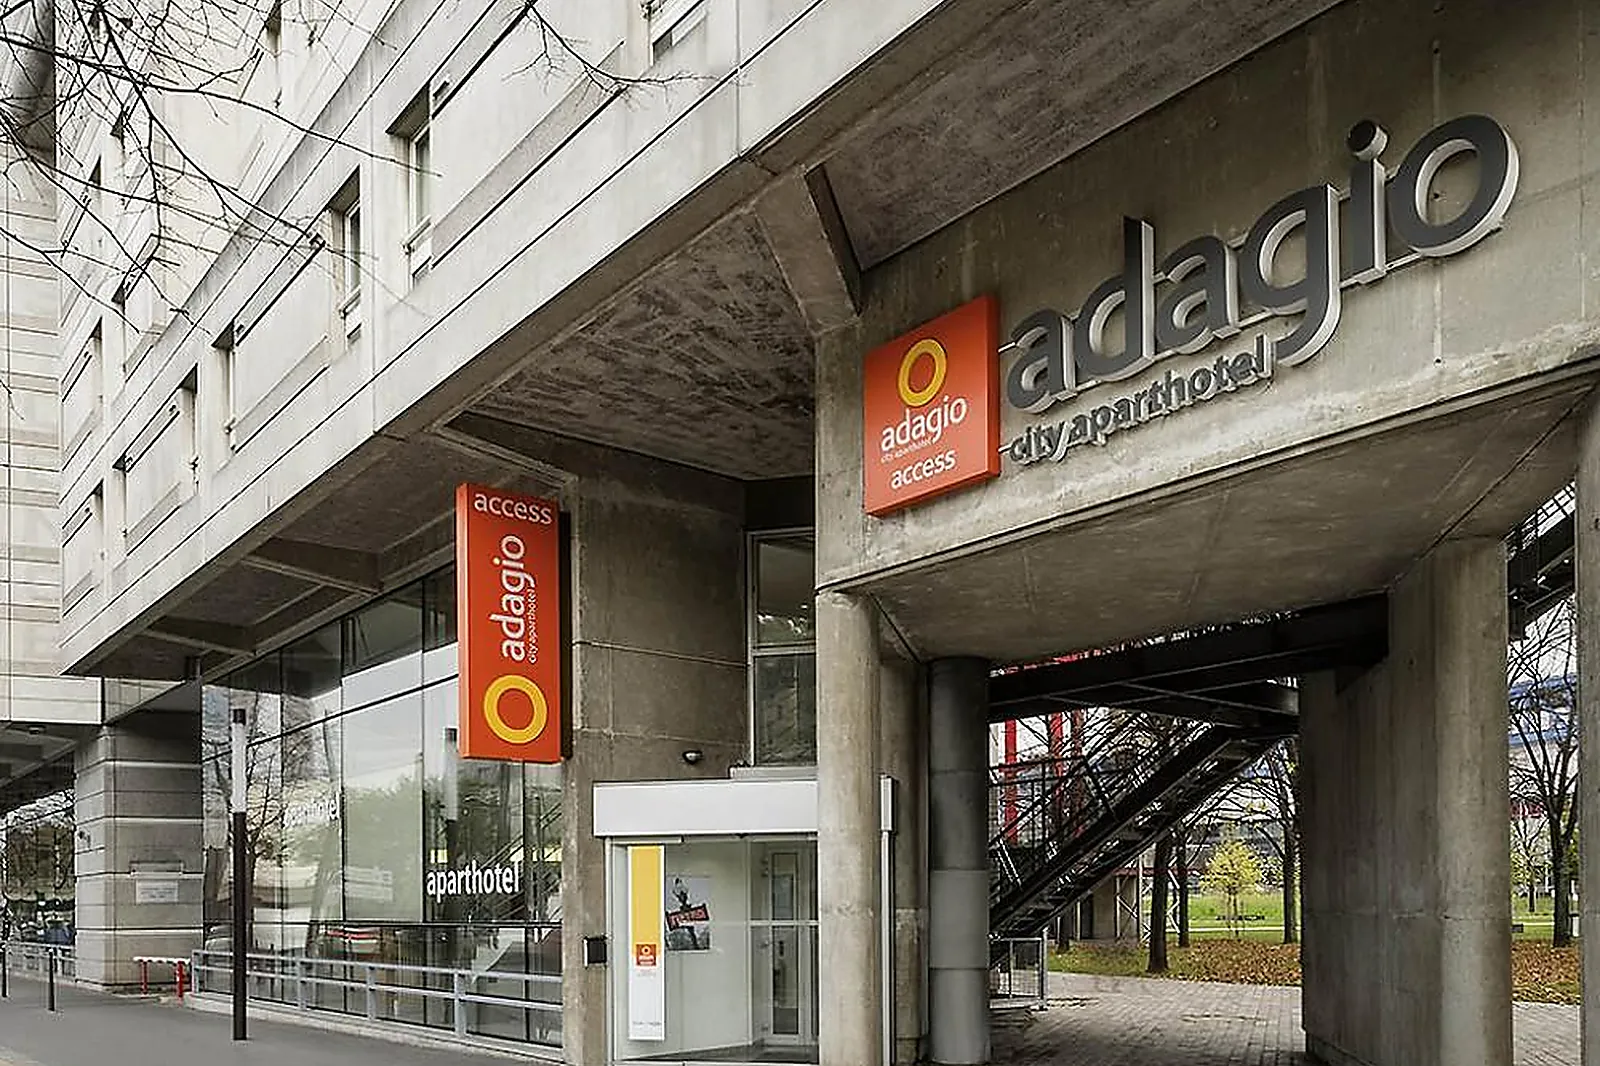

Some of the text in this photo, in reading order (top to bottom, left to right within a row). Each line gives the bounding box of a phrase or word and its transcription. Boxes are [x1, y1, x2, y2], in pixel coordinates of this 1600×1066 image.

[1006, 113, 1520, 414] adagio
[881, 395, 967, 452] adagio
[891, 450, 956, 489] access
[474, 493, 552, 525] access
[489, 535, 535, 662] adagio
[427, 859, 519, 903] aparthotel
